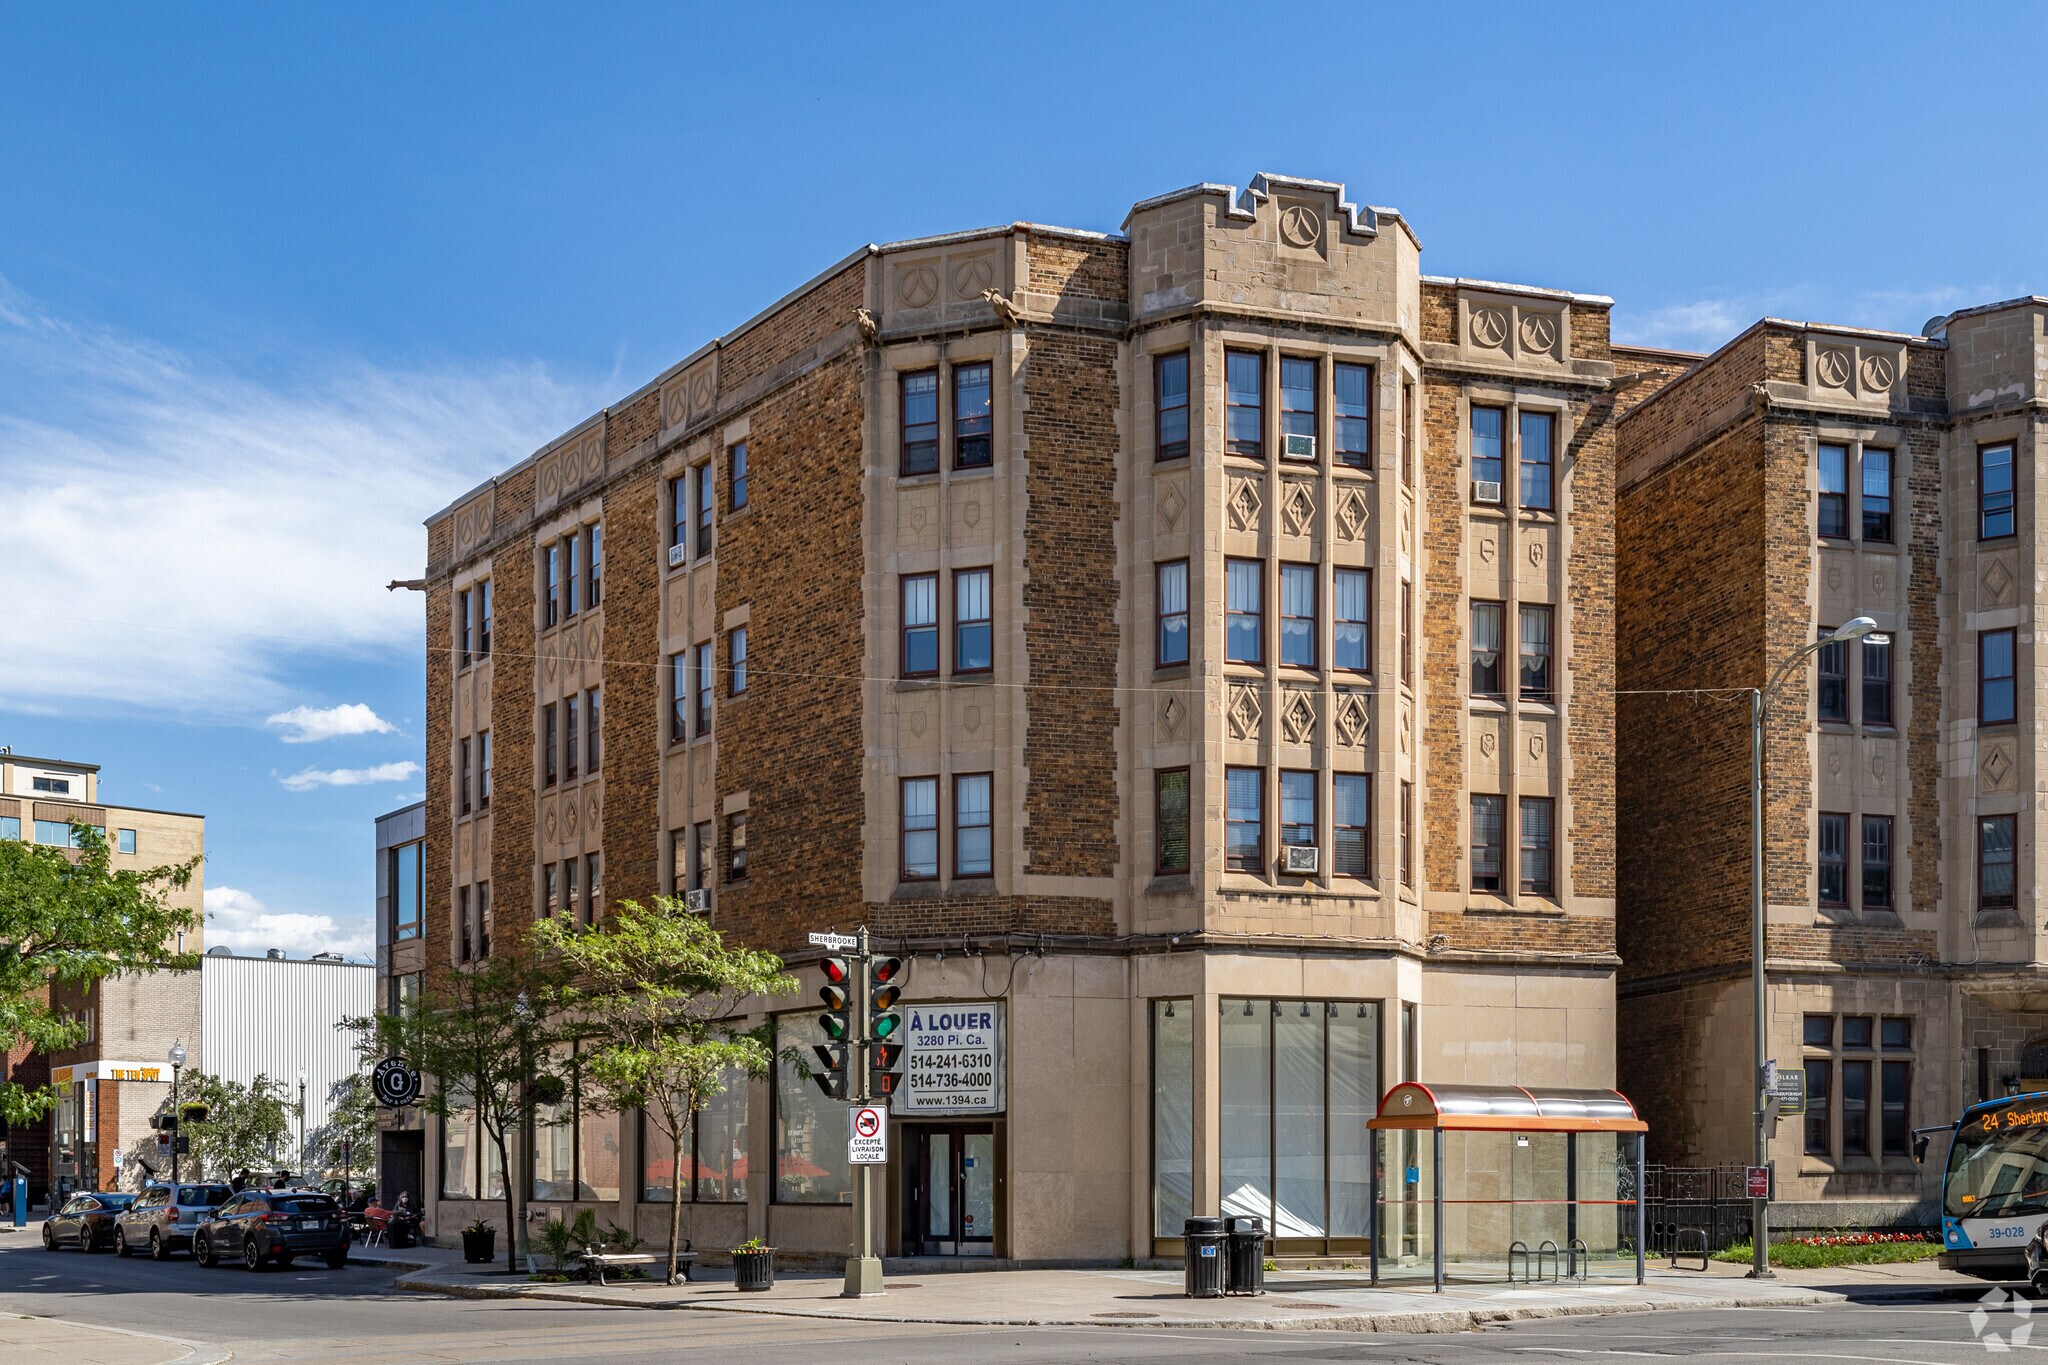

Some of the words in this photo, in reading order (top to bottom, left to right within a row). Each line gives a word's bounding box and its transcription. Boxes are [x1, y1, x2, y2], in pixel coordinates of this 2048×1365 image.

[810, 934, 856, 946] SHERBROOKE
[910, 1011, 923, 1031] À
[928, 1013, 992, 1031] LOUER
[917, 1035, 944, 1046] 3280
[948, 1034, 963, 1045] Pi.
[966, 1034, 985, 1045] Ca.
[910, 1053, 992, 1069] 514-241-6310
[390, 1072, 404, 1091] G
[910, 1072, 992, 1088] 514-736-4000
[916, 1095, 987, 1106] www.1394.ca
[1982, 1112, 1999, 1130] 24
[854, 1137, 882, 1146] EXCEPTÉ
[1989, 1226, 2025, 1239] 39-028
